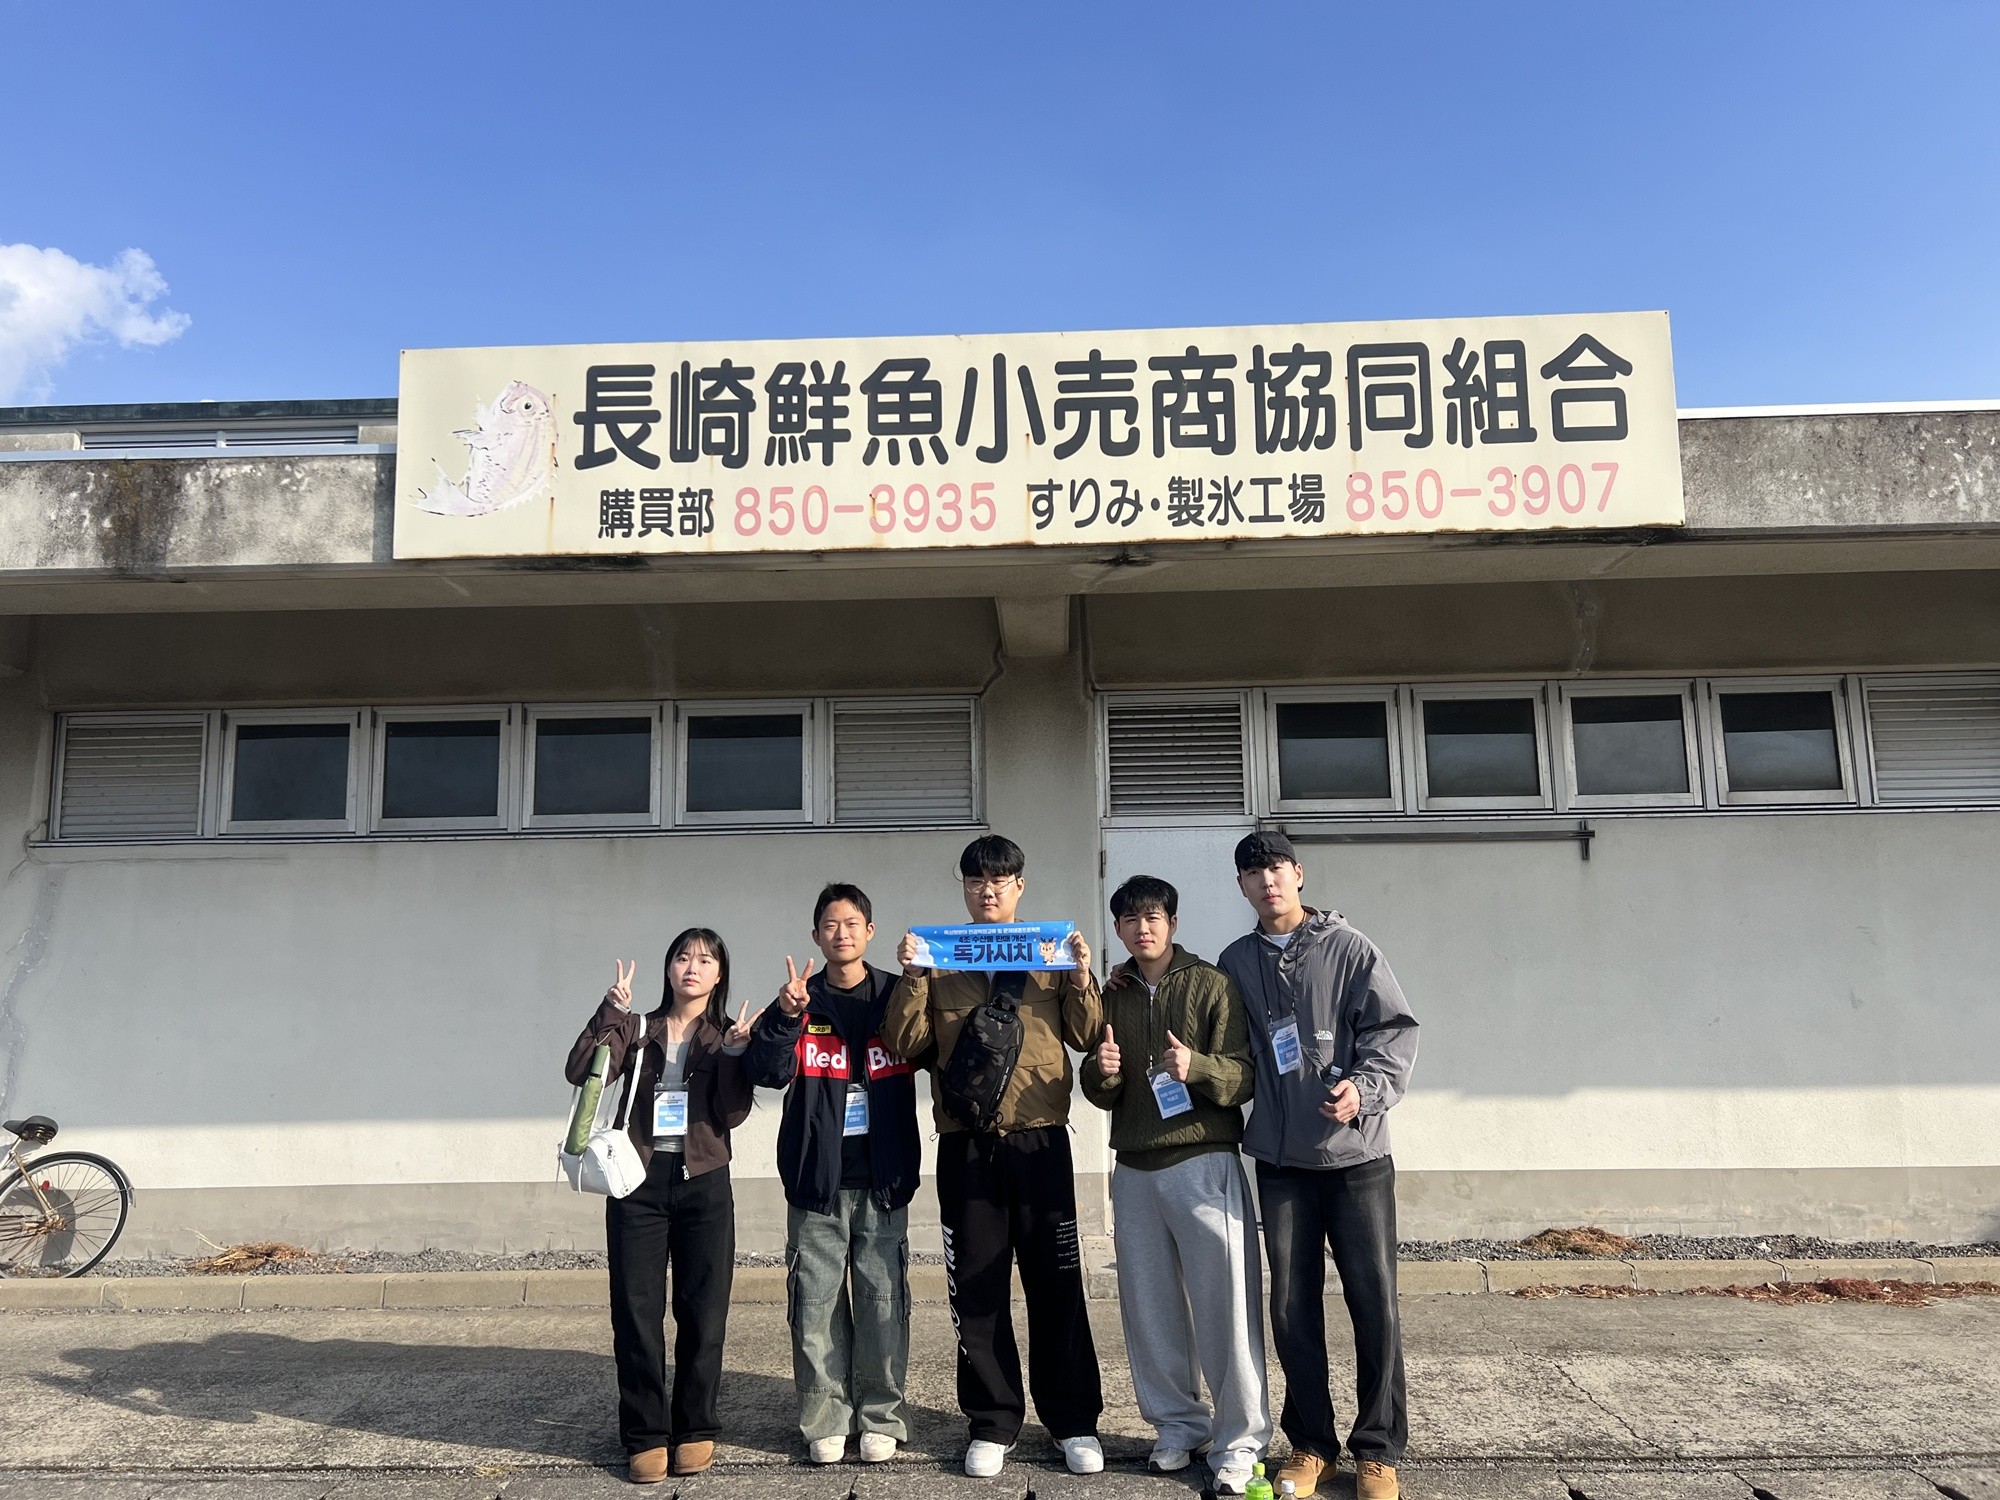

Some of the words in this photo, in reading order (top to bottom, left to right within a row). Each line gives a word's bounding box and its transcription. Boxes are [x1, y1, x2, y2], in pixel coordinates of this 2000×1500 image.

[573, 333, 1633, 471] 長崎鮮魚小売商協同組合
[598, 486, 714, 539] 購買部
[735, 482, 996, 536] 850-3935
[1026, 472, 1326, 530] すりみ・製氷工場
[1347, 463, 1617, 521] 850-3907
[953, 942, 1033, 964] 독가시치
[806, 1042, 847, 1070] Red
